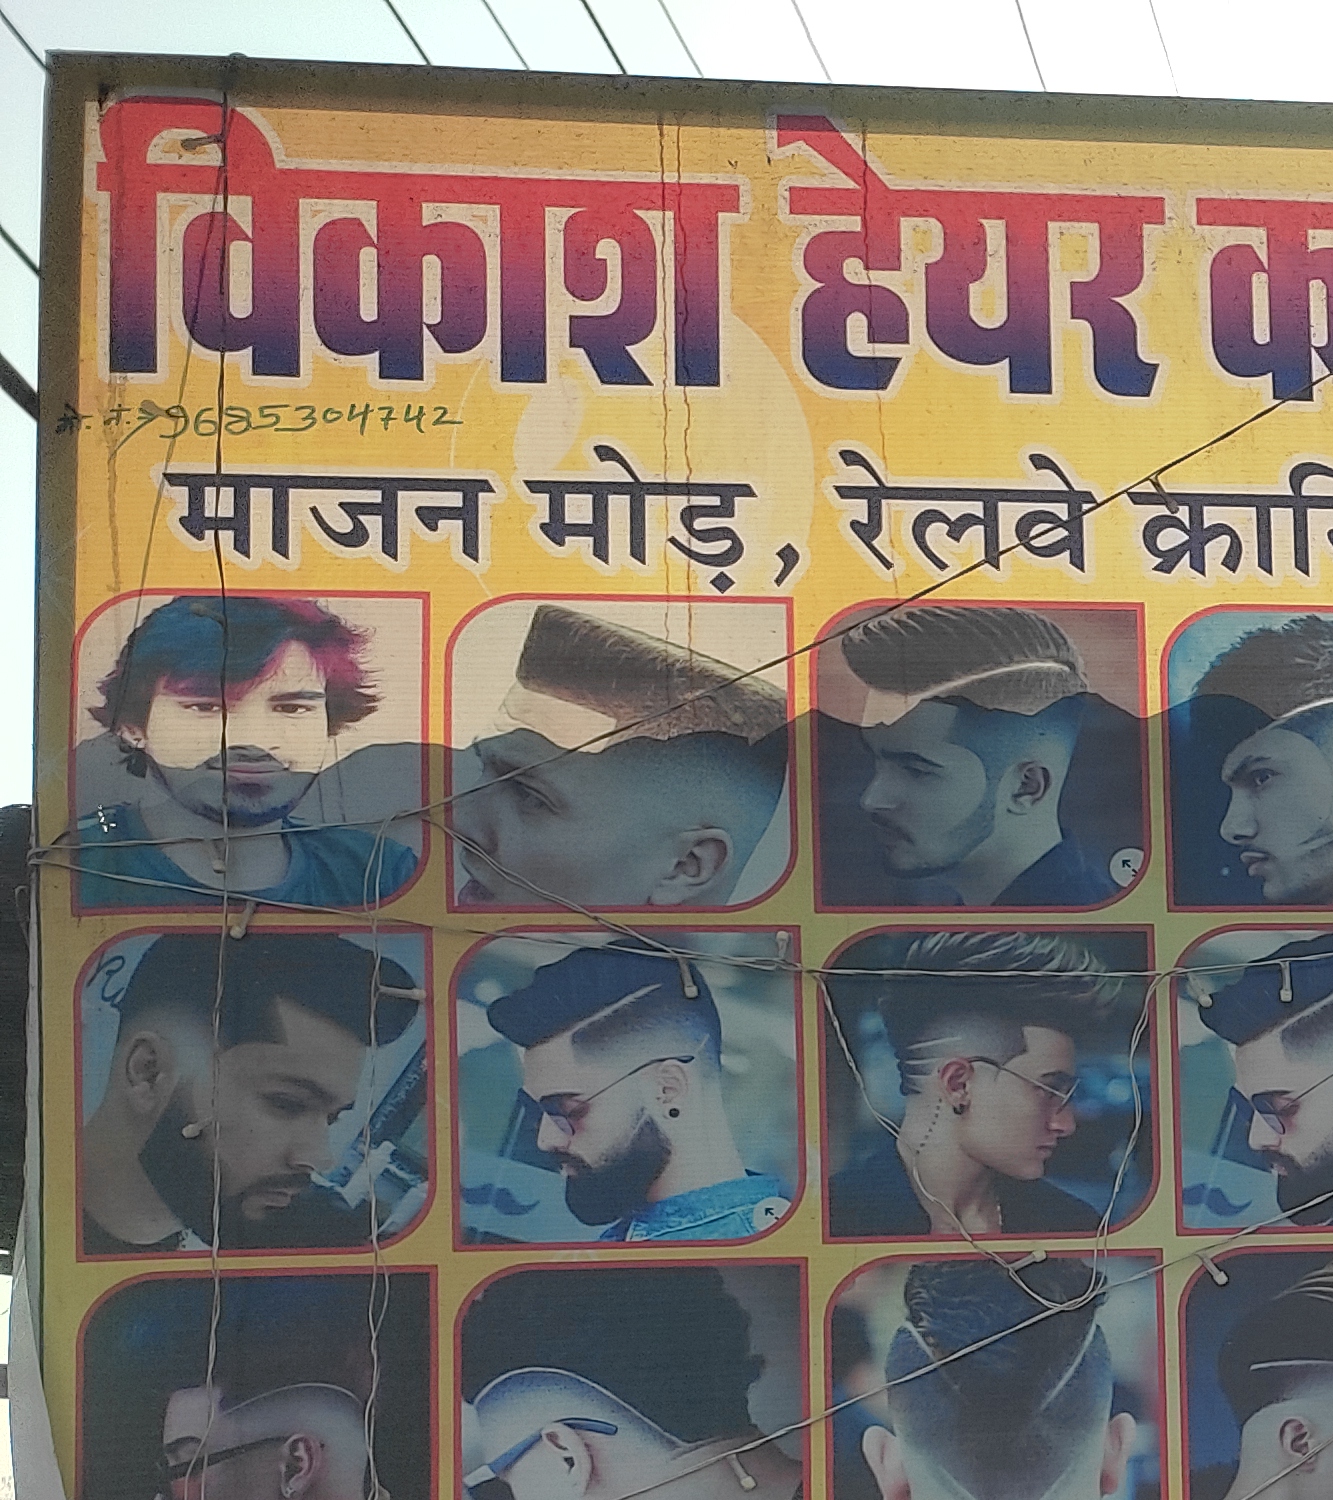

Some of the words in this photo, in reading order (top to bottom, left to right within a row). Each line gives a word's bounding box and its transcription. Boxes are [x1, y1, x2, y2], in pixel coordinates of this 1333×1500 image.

[98, 96, 738, 387] विकाश
[776, 114, 1165, 397] हेयर
[163, 472, 492, 562] माजन
[835, 449, 1098, 571] रेलवे
